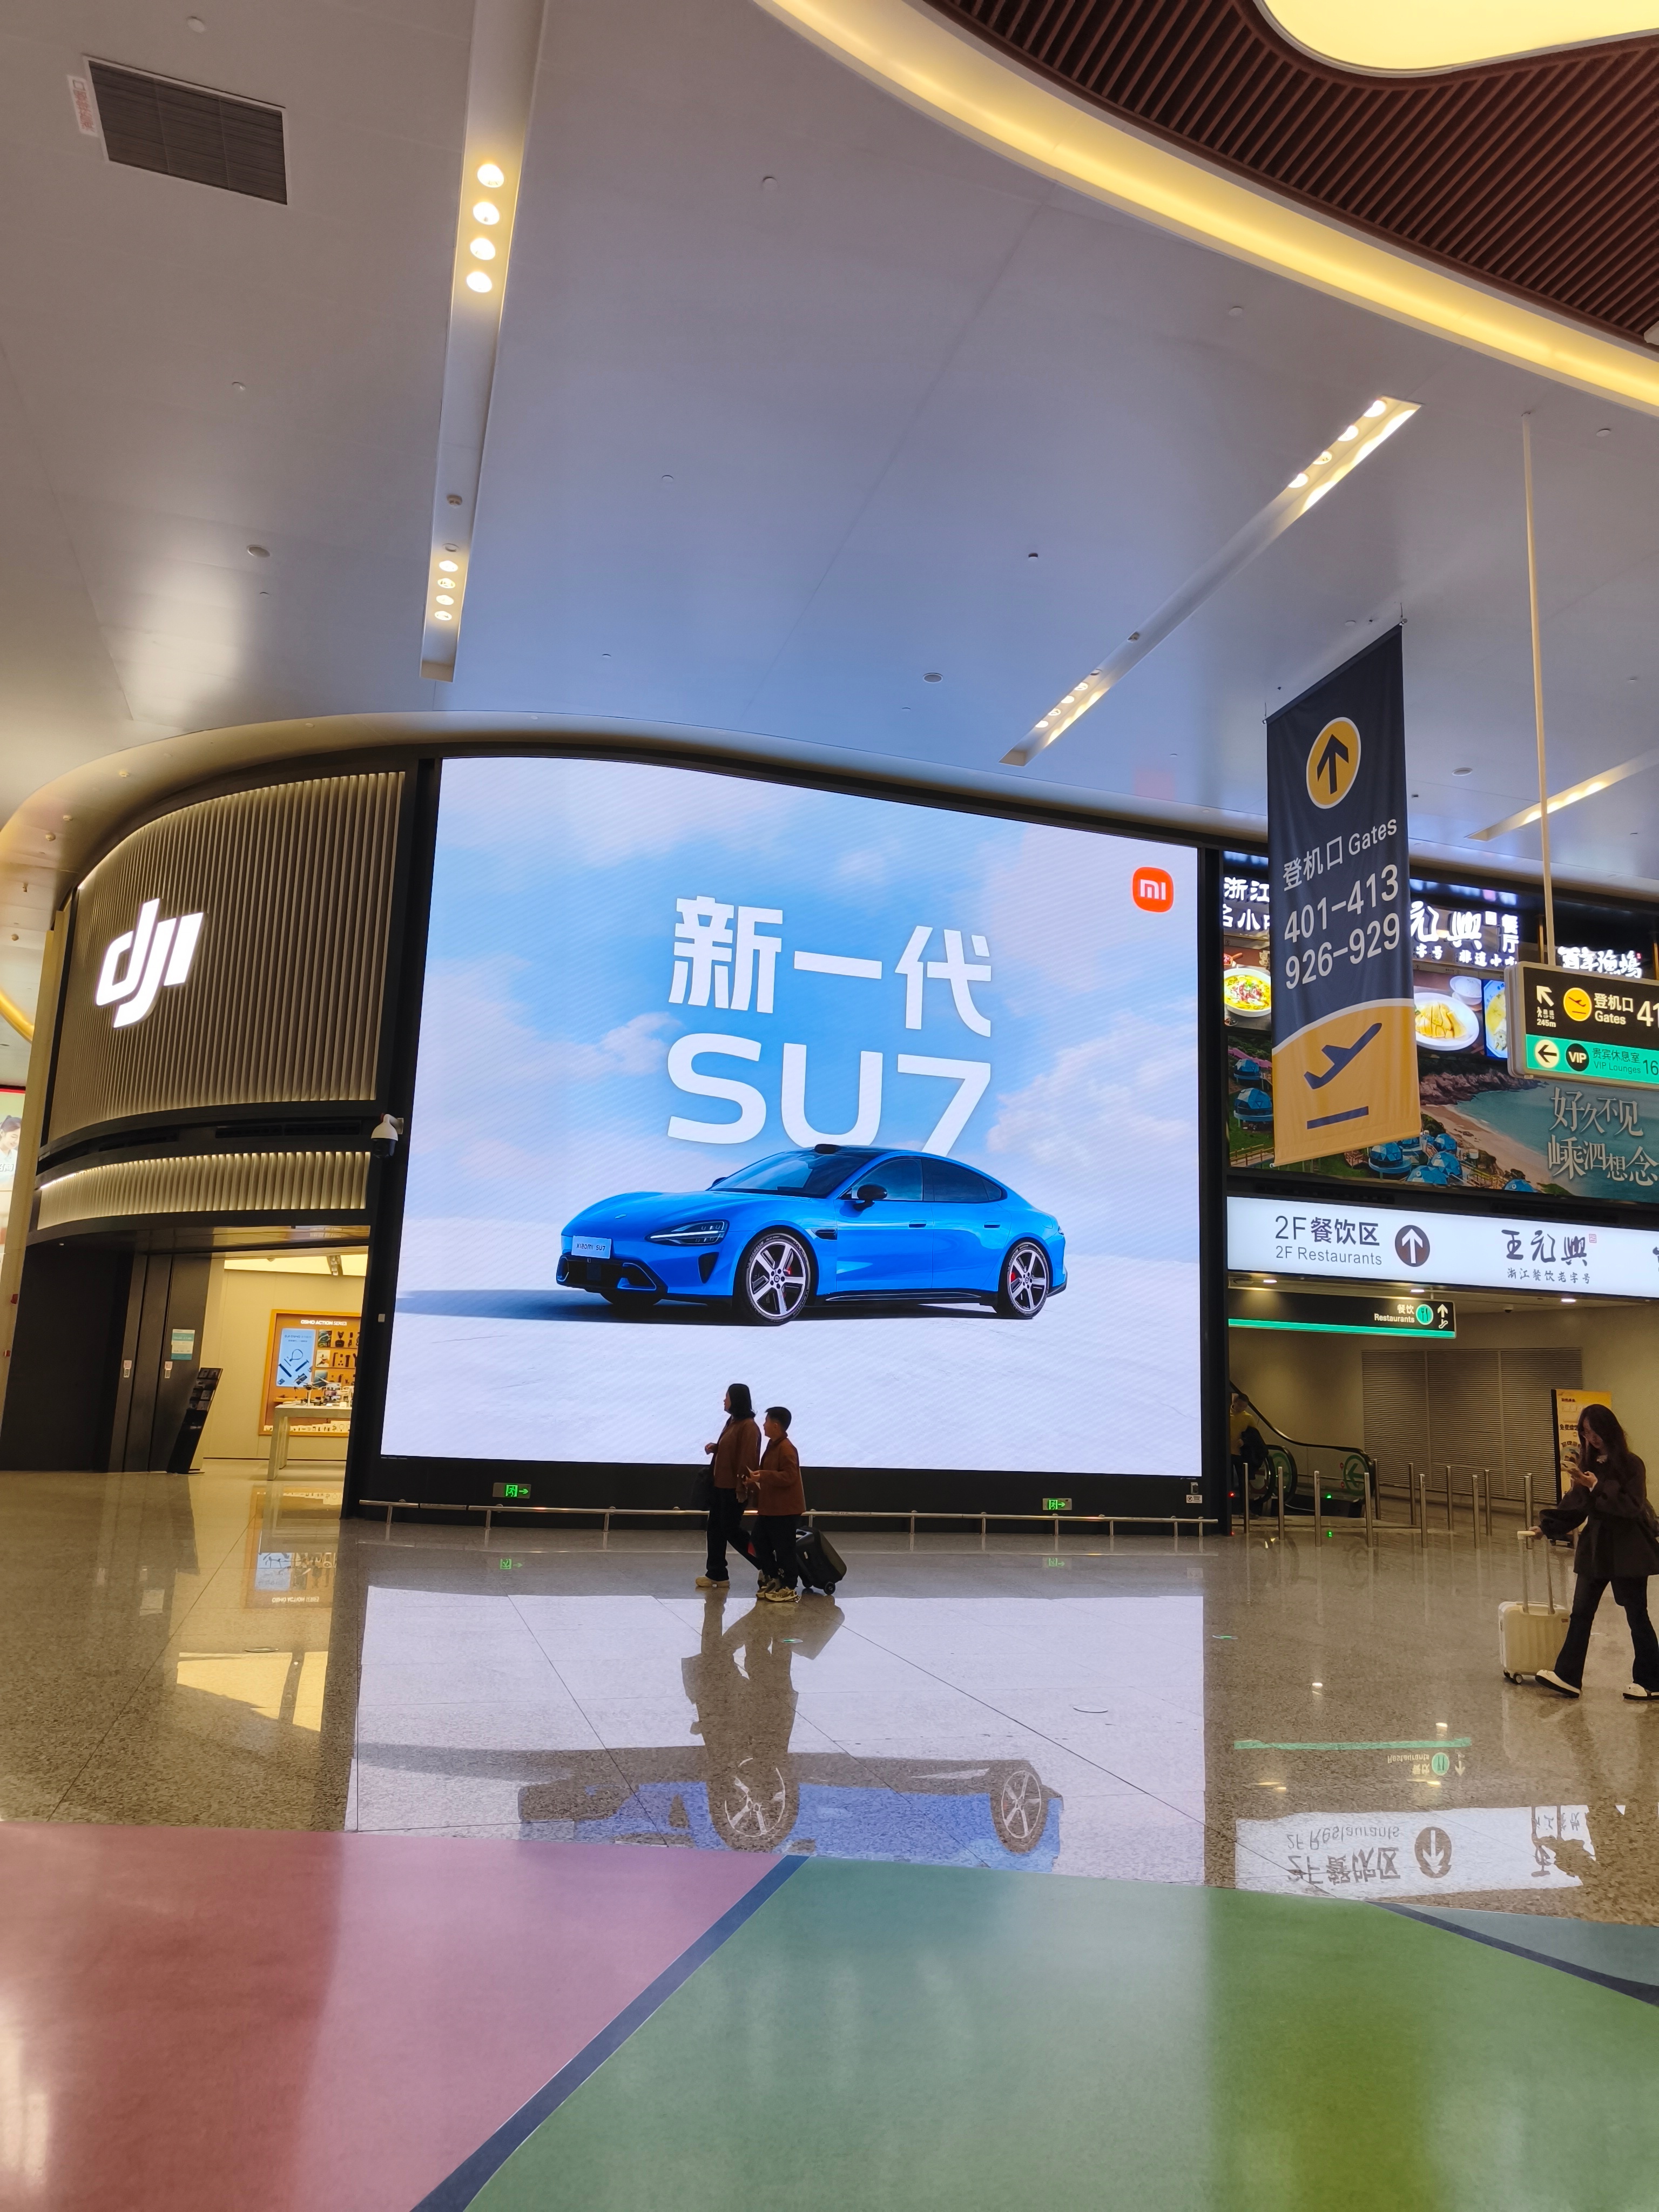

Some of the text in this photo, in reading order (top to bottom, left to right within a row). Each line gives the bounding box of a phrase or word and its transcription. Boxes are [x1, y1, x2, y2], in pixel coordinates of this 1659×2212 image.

[1283, 819, 1397, 891] 登机口 Gates
[1224, 877, 1270, 902] 浙江
[1284, 864, 1399, 943] 401-413
[1285, 913, 1400, 989] 926-929
[669, 895, 992, 1037] 新一代
[1594, 993, 1634, 1013] 登机口
[1537, 1018, 1556, 1028] 245m
[1595, 1010, 1626, 1025] Gates
[1568, 1051, 1587, 1063] VIP
[1593, 1048, 1659, 1076] 贵宾休息室 16
[1594, 1061, 1641, 1074] VIP Lounges
[667, 1033, 991, 1157] SU7
[1549, 1087, 1644, 1136] 好久不见
[1548, 1135, 1659, 1186] 嵊泗想念
[1276, 1245, 1382, 1265] 2F Restaurants
[1507, 1267, 1590, 1284] 浙江餐饮老字号
[1374, 1313, 1415, 1323] Restaurants
[1397, 1304, 1415, 1315] 餐饮
